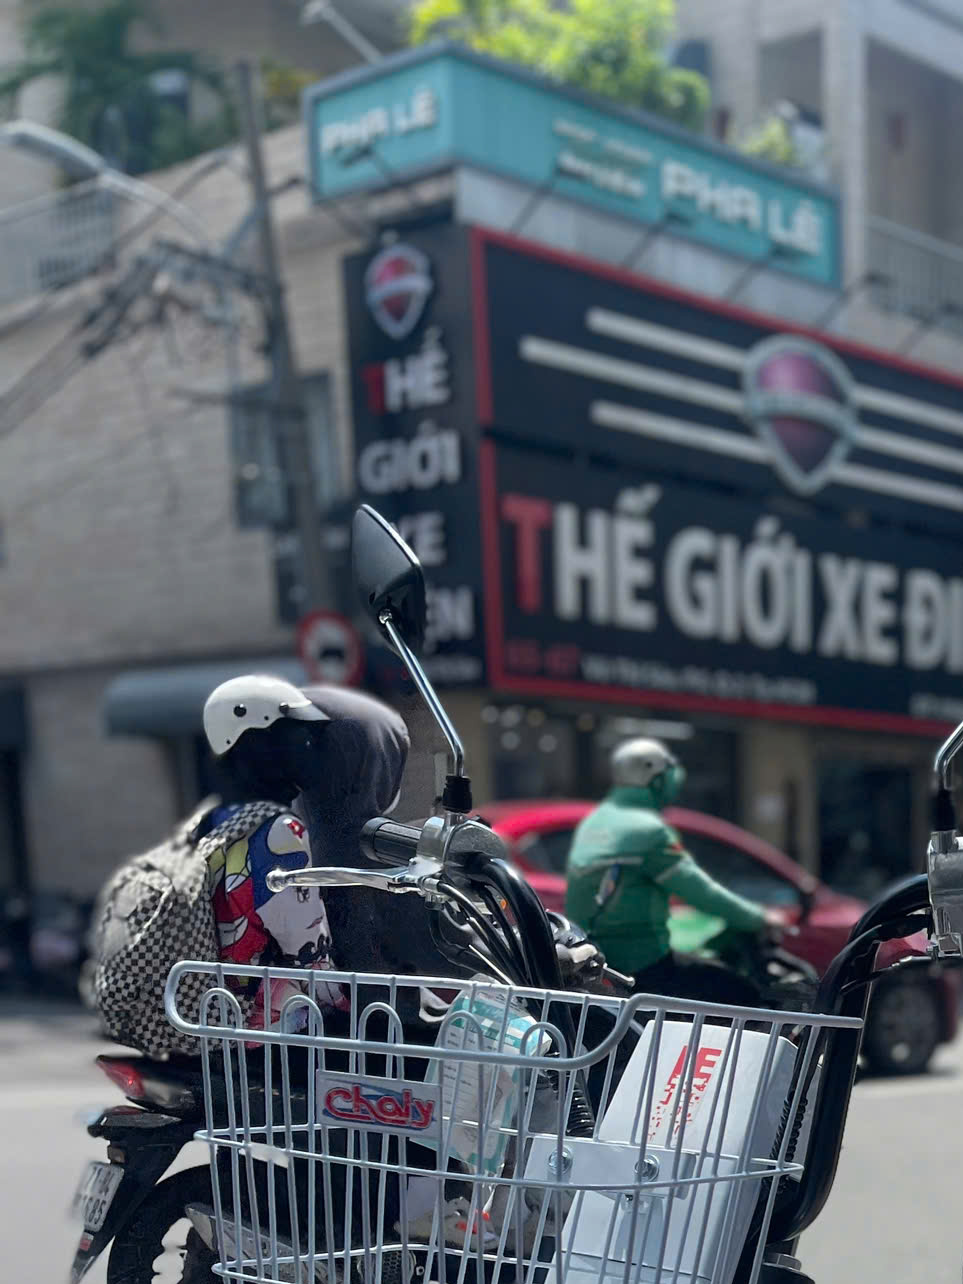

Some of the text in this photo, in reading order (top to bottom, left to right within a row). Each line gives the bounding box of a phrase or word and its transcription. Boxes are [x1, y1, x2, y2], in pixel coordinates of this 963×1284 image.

[360, 421, 461, 493] GIỚI
[503, 484, 664, 632] THẾ
[664, 515, 811, 654] GIỚI
[818, 553, 899, 666] XE
[325, 1085, 435, 1129] Chaly
